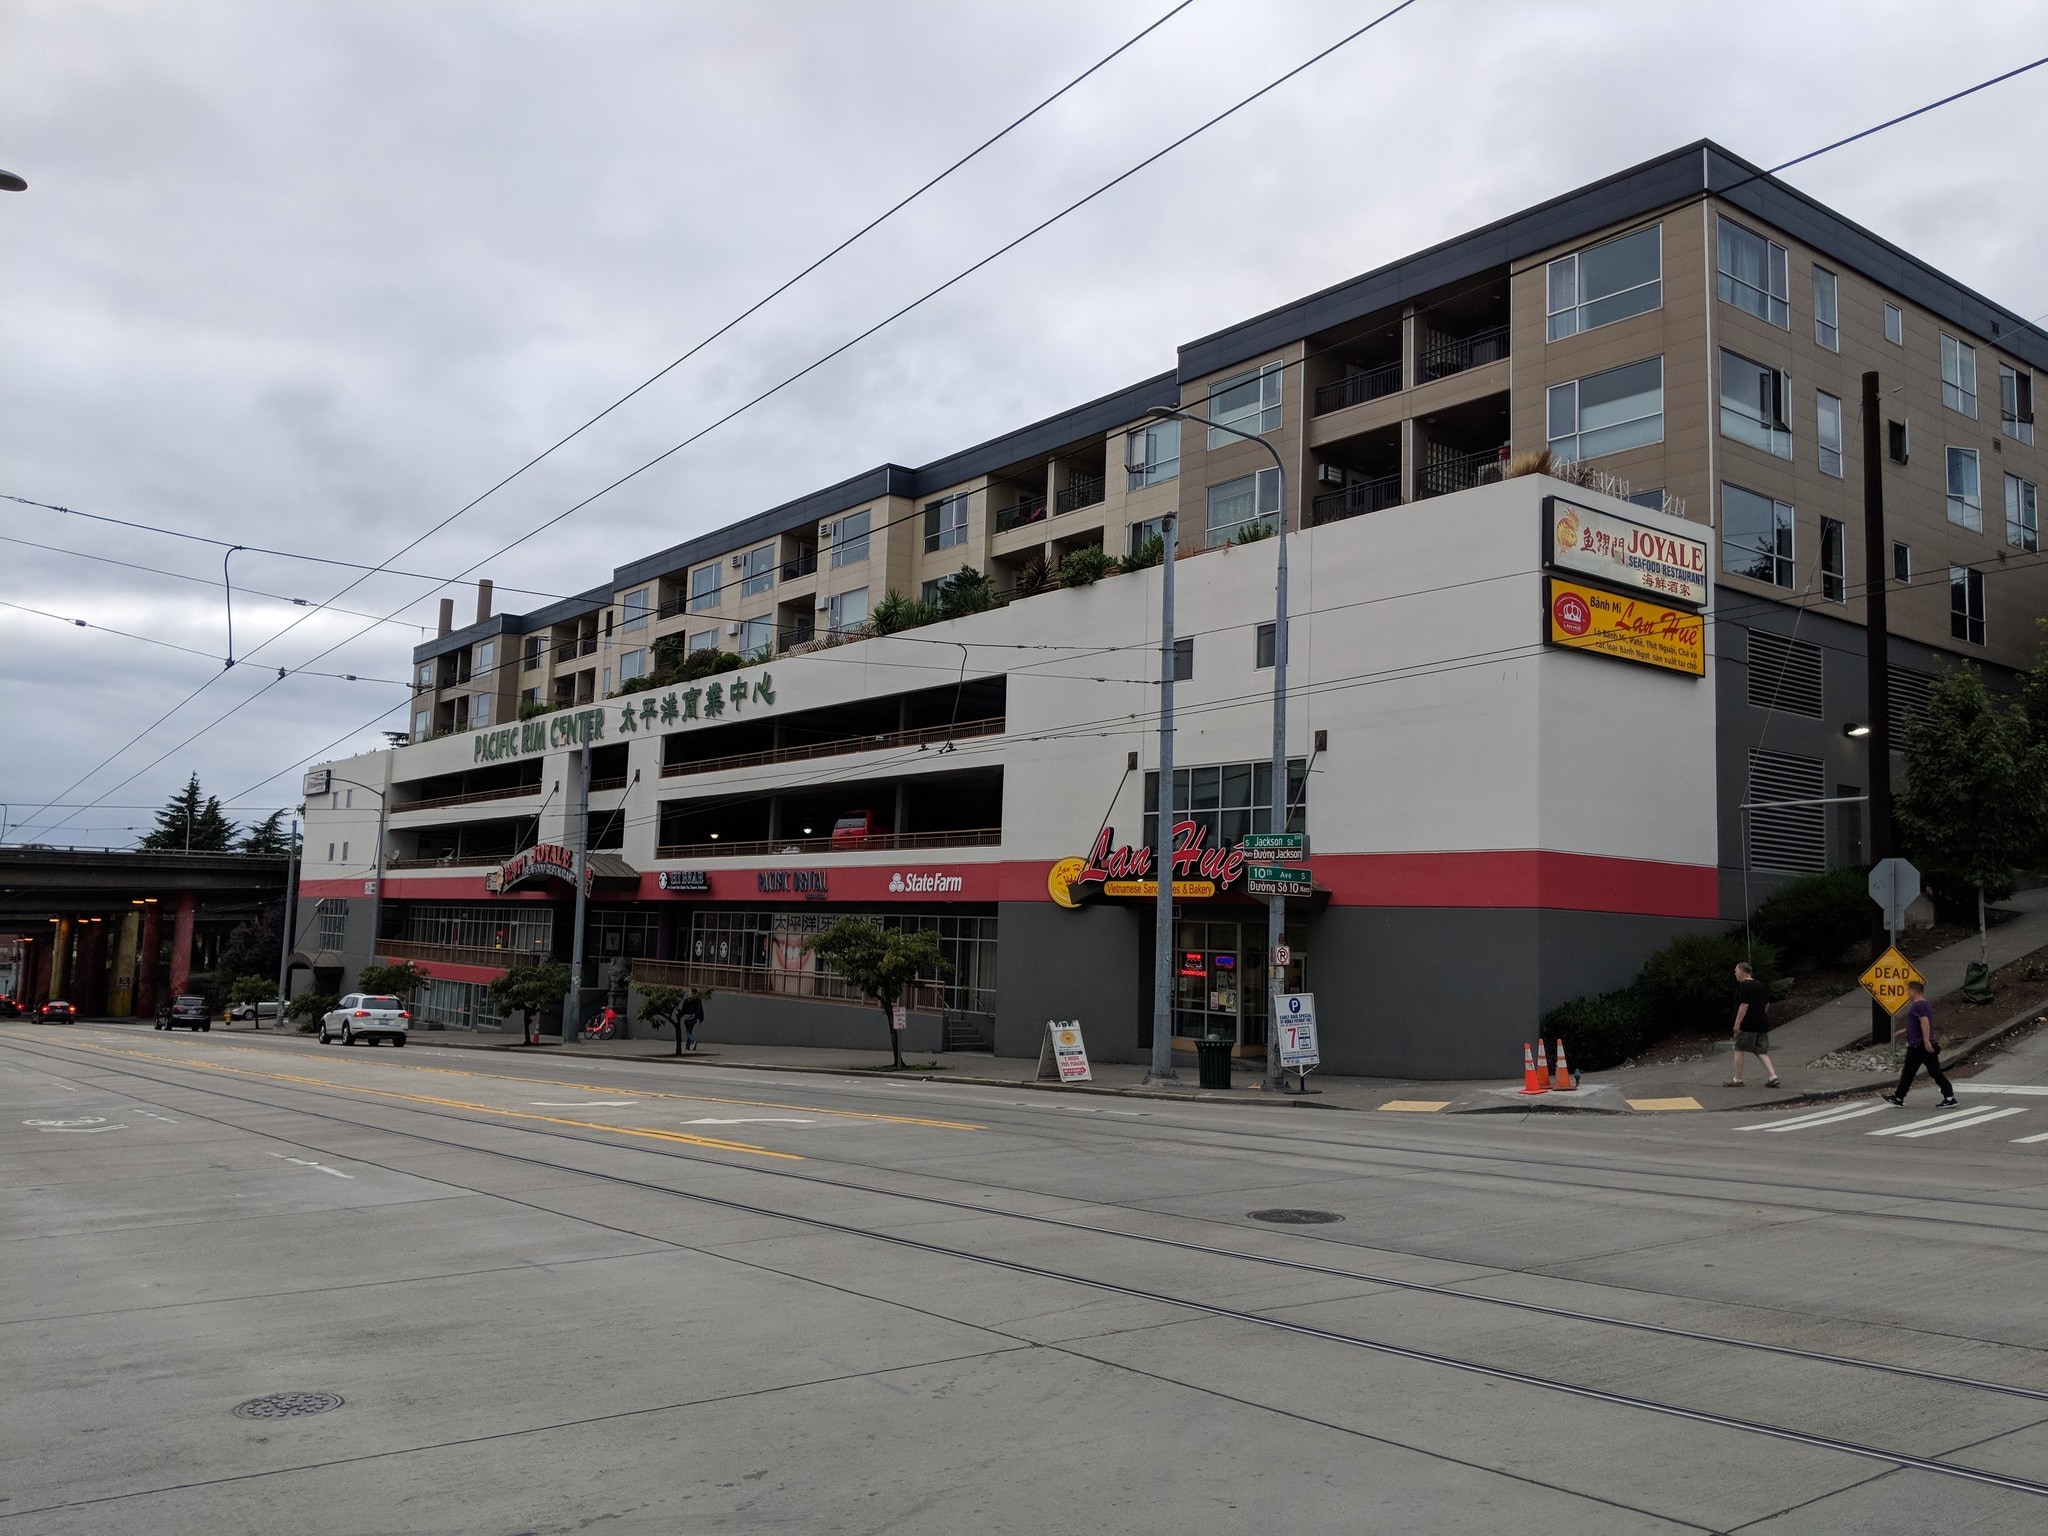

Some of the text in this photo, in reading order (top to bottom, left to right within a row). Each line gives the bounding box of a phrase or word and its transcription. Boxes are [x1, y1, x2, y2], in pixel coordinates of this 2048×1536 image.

[1627, 529, 1704, 572] JOYALE
[1628, 555, 1704, 587] SEAFOOD RESTAURANT
[1641, 572, 1692, 597] 海鮮酒家
[1590, 595, 1609, 611] Bánh
[1615, 602, 1655, 635] Lan
[473, 707, 605, 763] PACIFIC RIM CENTER
[1245, 839, 1250, 847] S
[1254, 837, 1283, 847] Jackson
[531, 844, 572, 869] JOYALE
[1078, 826, 1151, 885] Lan
[1275, 849, 1302, 859] Jackson
[758, 870, 828, 892] PACIFIC DENTAL
[1253, 867, 1306, 880] 10th Ave S
[1107, 884, 1142, 895] Vietnamese
[1182, 884, 1188, 894] &
[1189, 884, 1213, 896] Bakery
[1289, 883, 1299, 893] 10
[1875, 967, 1910, 979] DEAD
[1879, 984, 1905, 997] END
[1291, 1000, 1299, 1011] P
